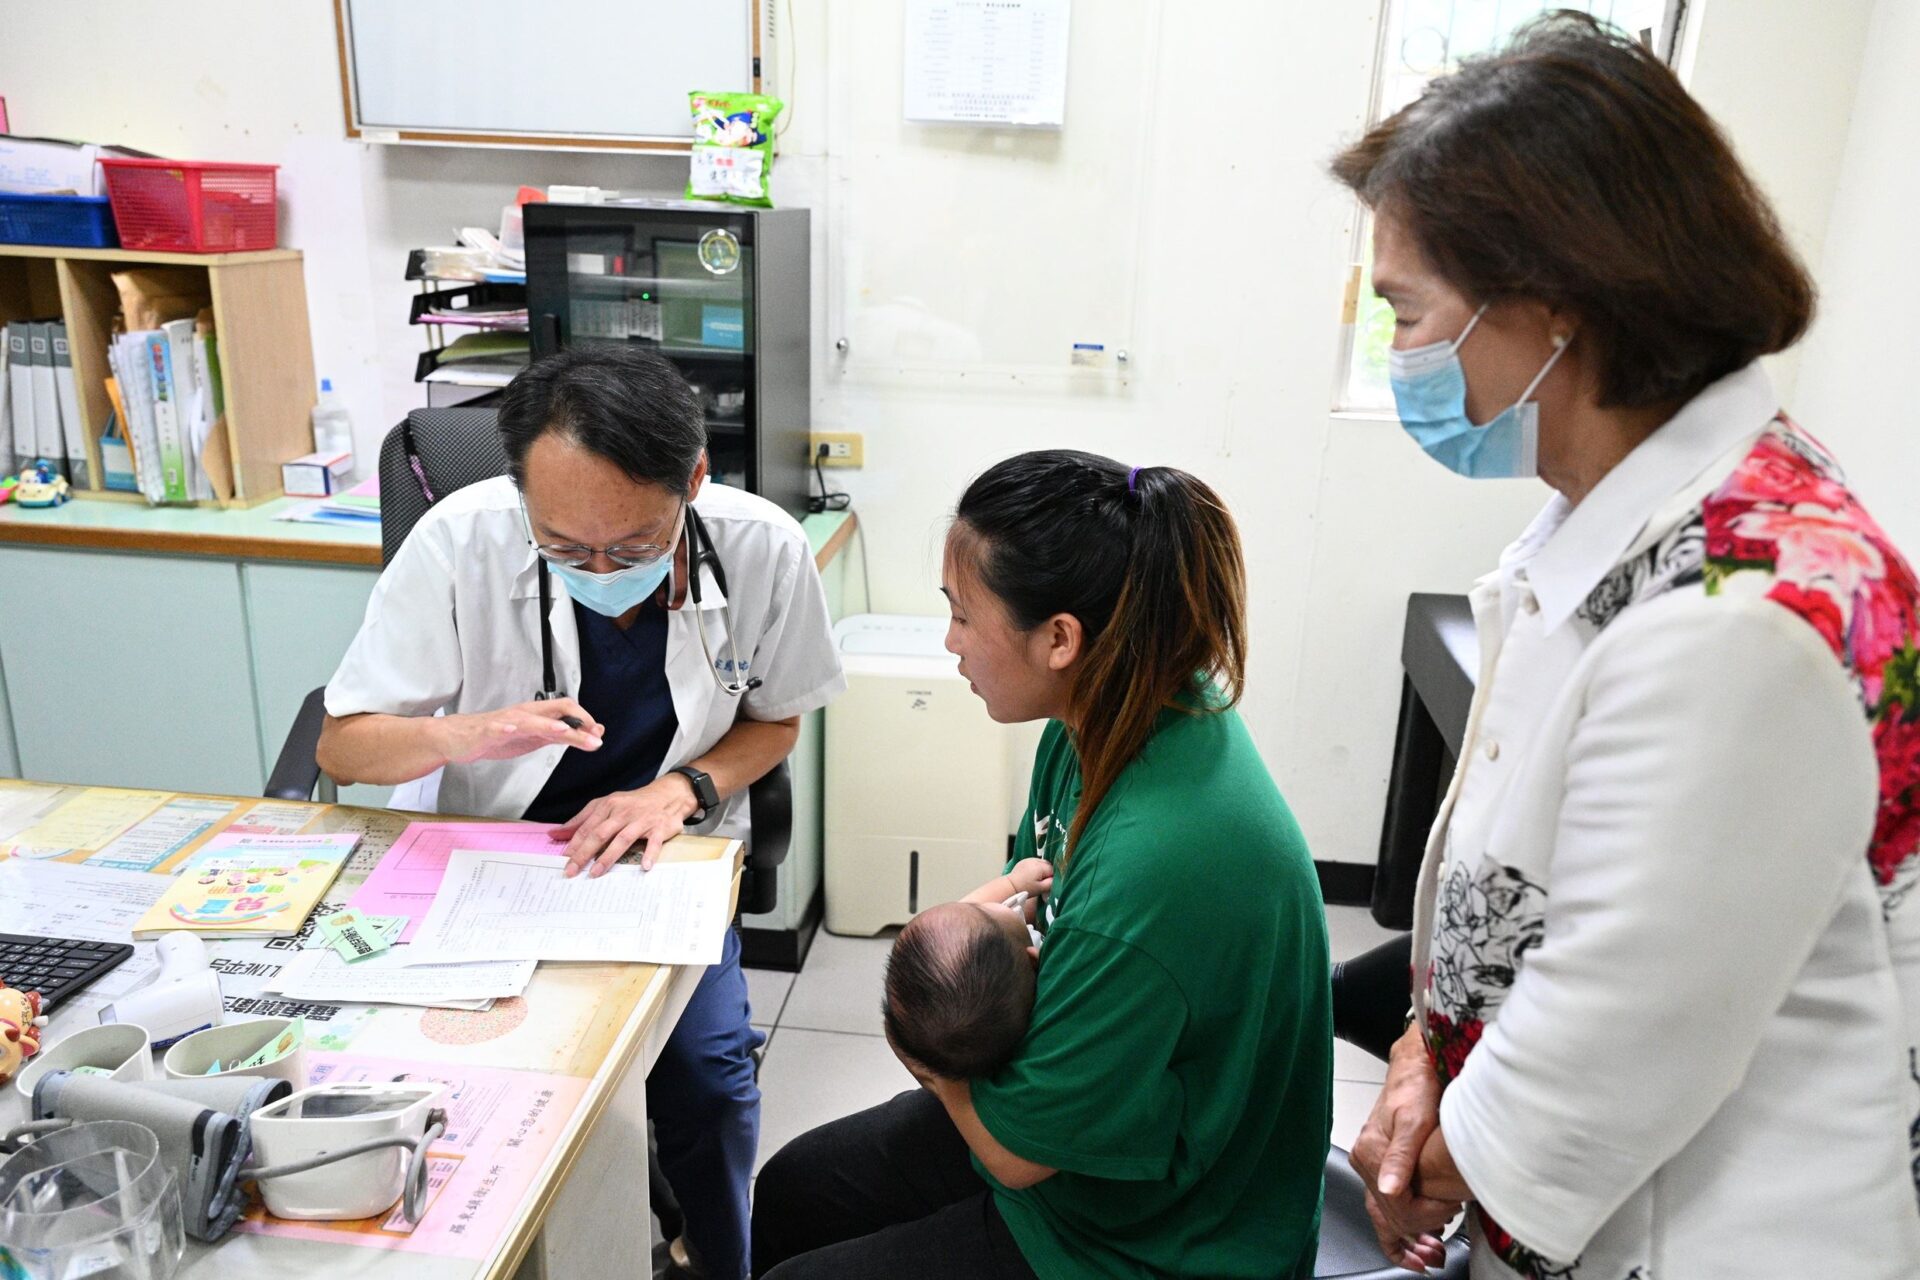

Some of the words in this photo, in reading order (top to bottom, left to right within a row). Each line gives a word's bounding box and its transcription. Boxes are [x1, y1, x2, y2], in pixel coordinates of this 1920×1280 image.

[449, 1164, 506, 1234] 羅東鎮衛生所
[506, 1089, 554, 1148] 關心您的健康
